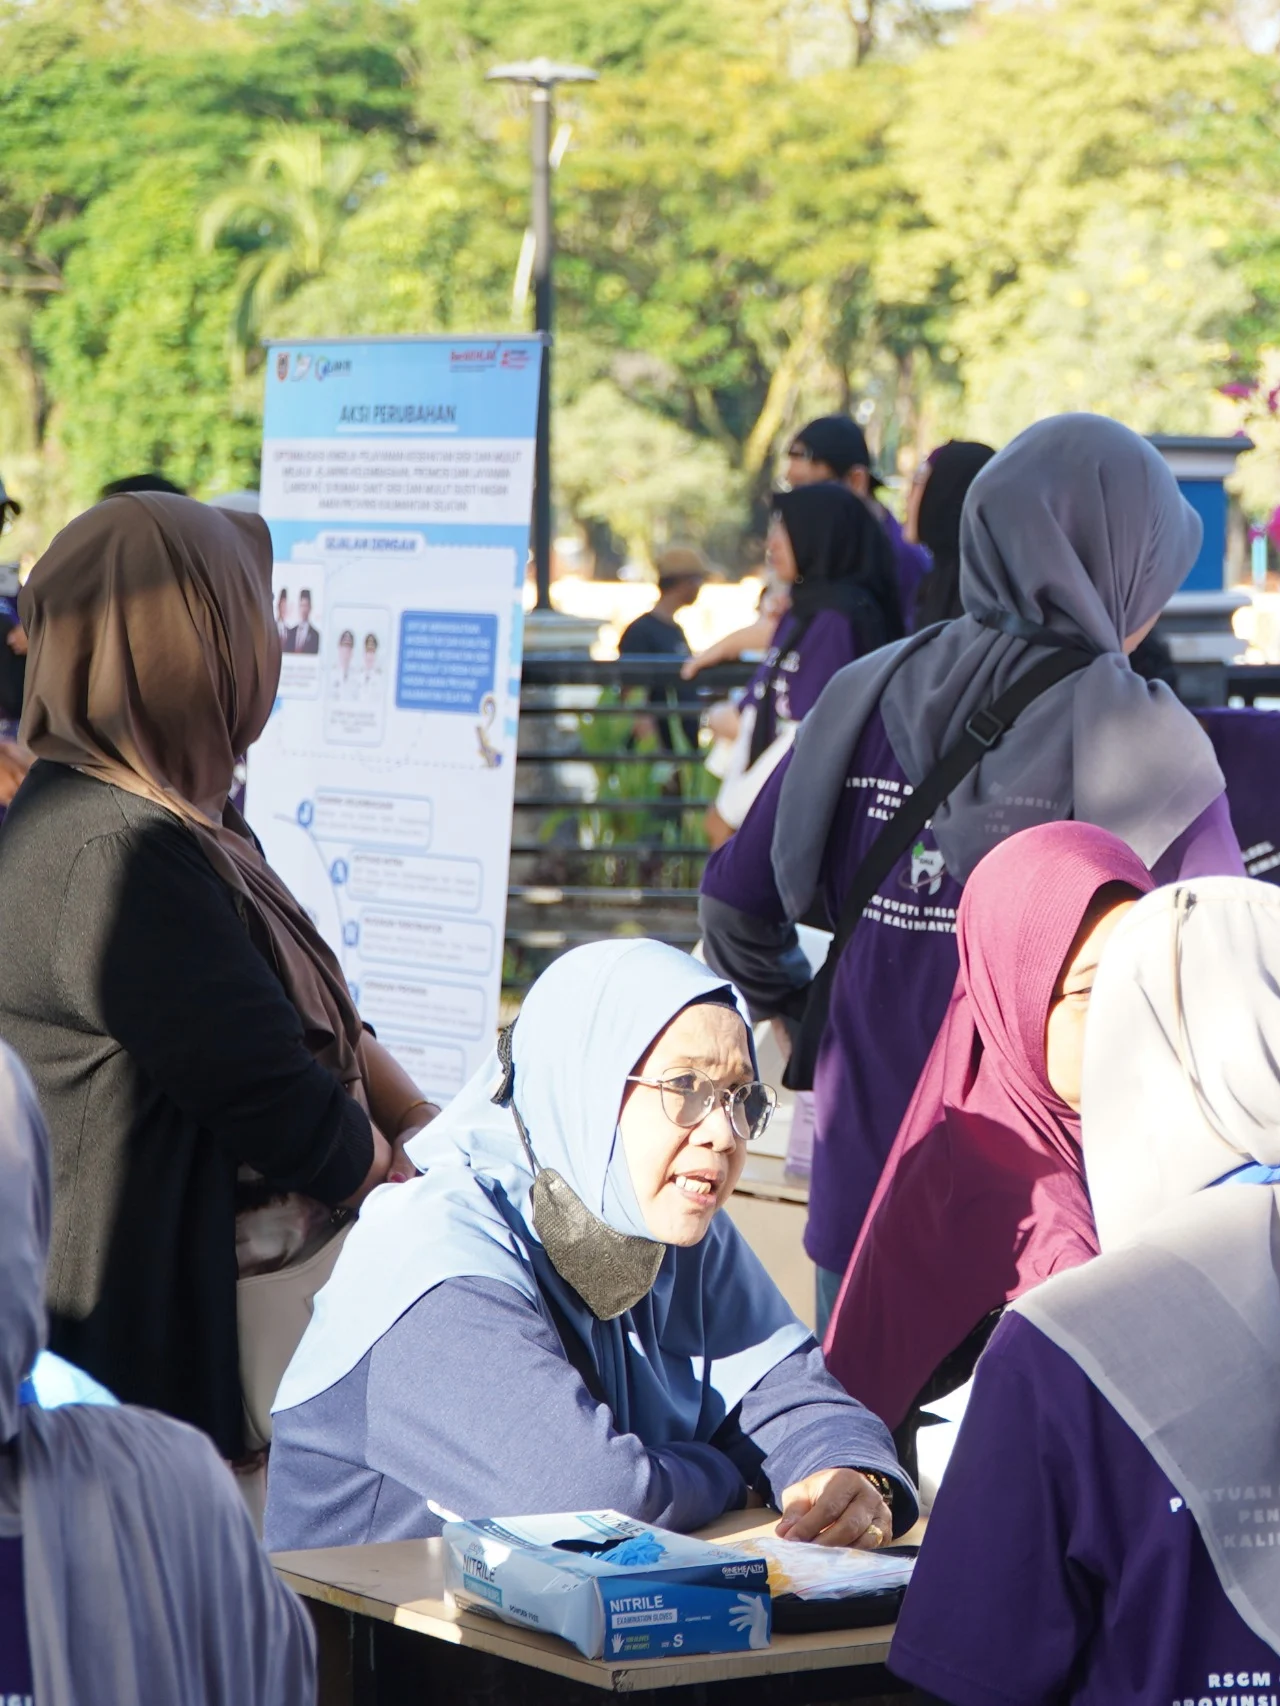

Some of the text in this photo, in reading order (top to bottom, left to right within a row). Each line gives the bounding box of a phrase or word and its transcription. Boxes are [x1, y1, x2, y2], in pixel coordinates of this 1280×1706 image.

[339, 404, 457, 424] AKSI PERUBAHAN
[610, 1595, 664, 1613] NITRILE
[616, 1612, 673, 1625] EXAMINATION GLOVES
[673, 1633, 684, 1648] S
[1208, 1672, 1271, 1688] RSGM
